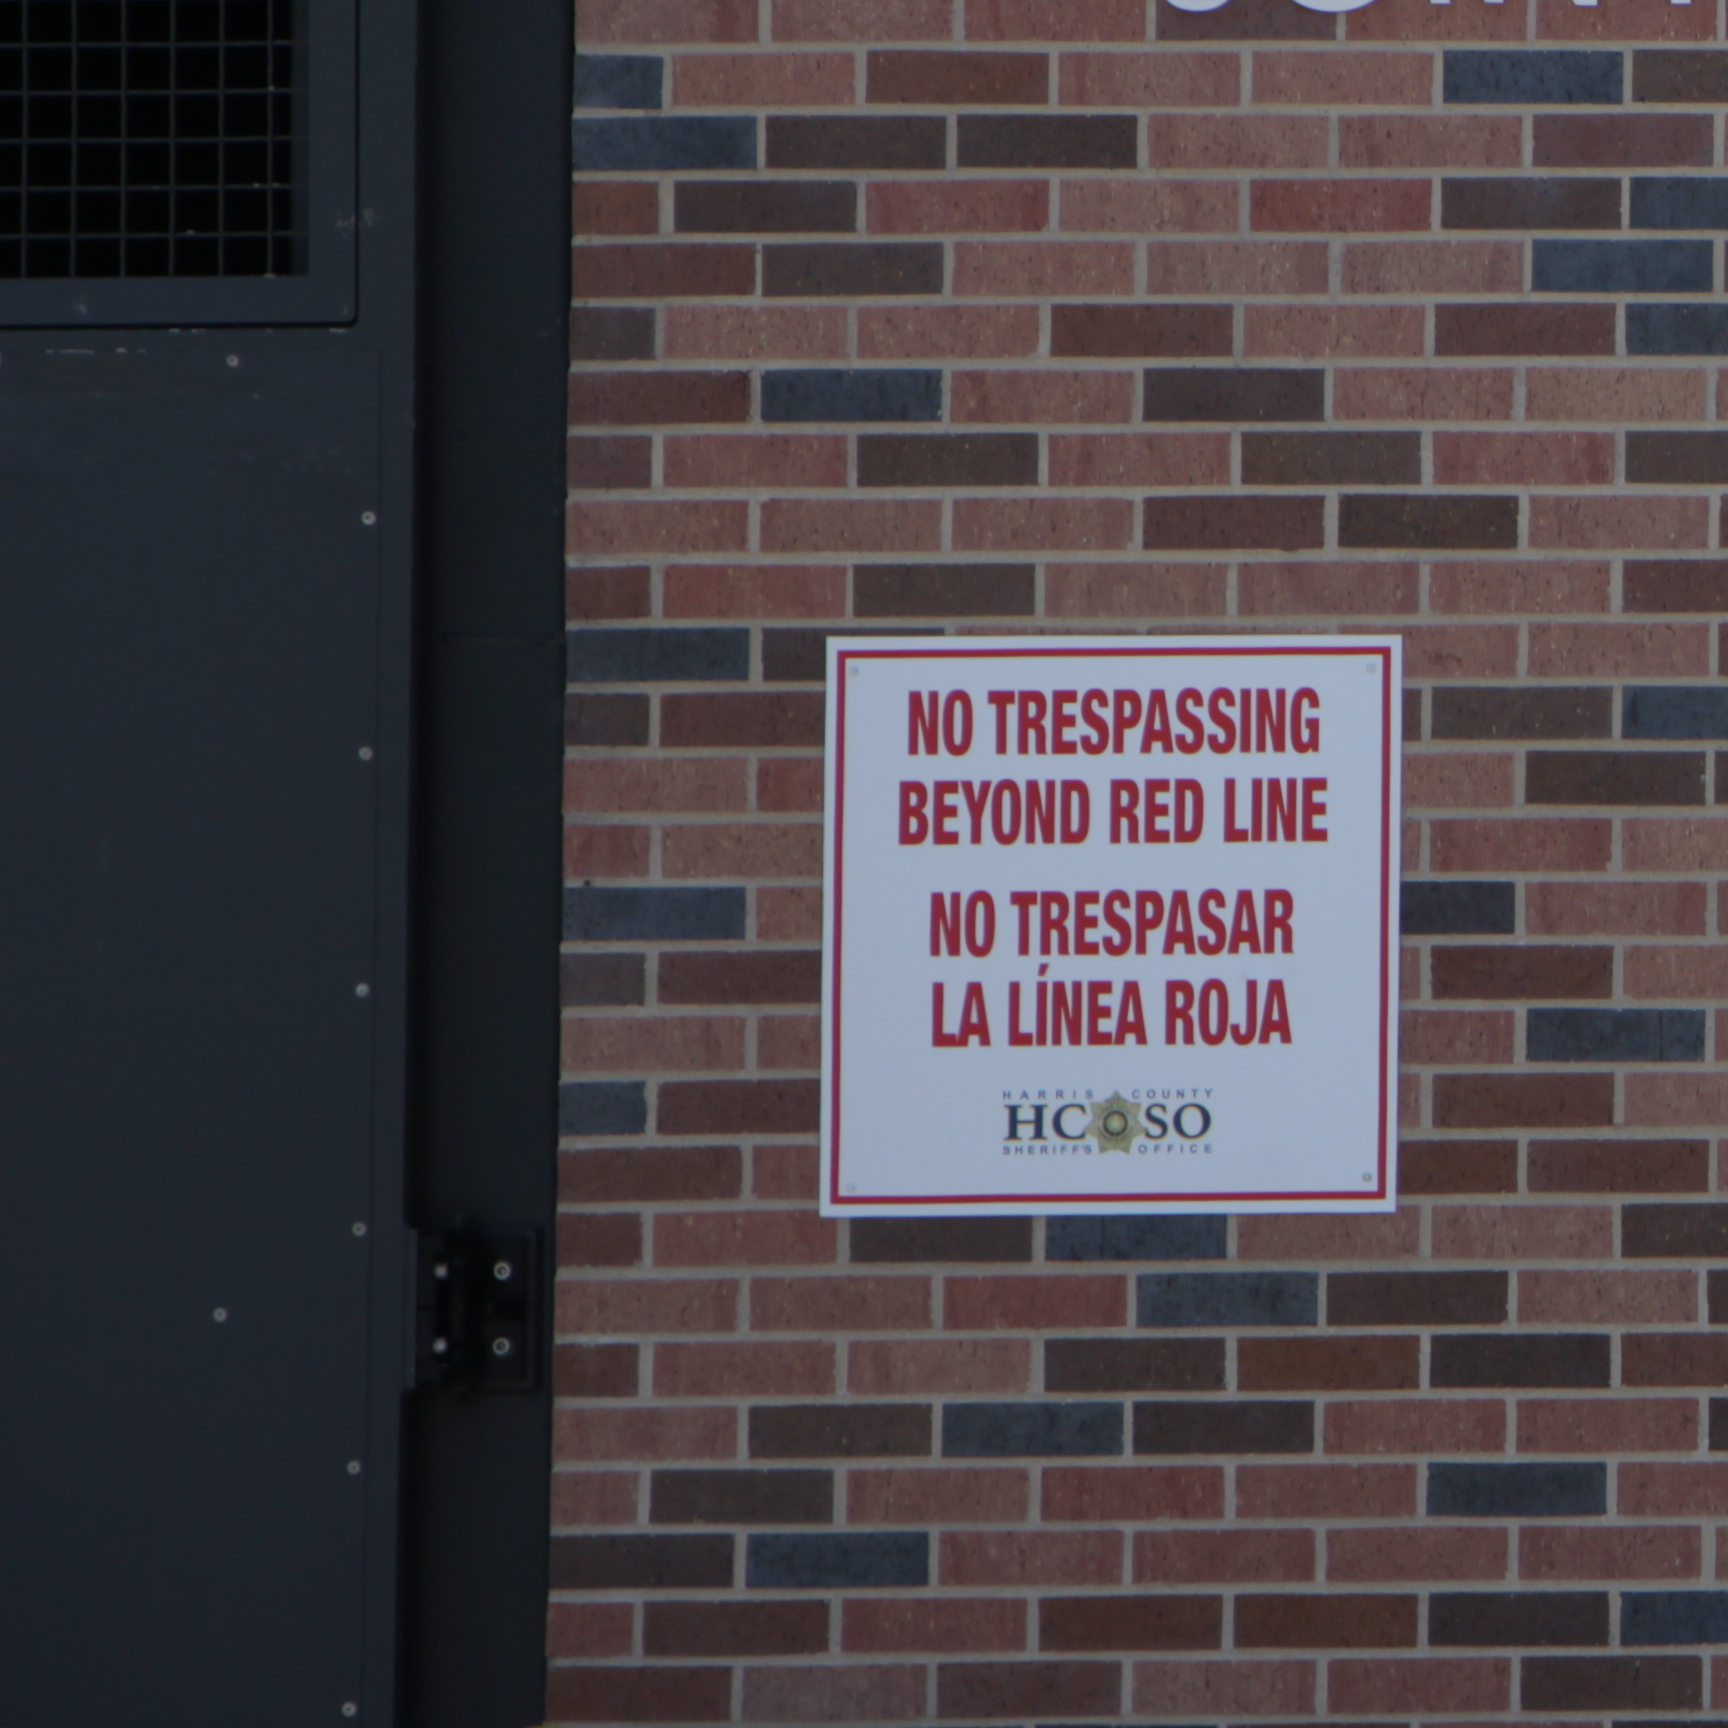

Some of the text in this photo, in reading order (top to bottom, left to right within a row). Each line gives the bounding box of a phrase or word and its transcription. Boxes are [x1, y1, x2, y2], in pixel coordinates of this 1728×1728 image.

[907, 687, 1320, 756] NO TRESPASSING
[899, 777, 1329, 846] BEYOND RED LINE
[929, 888, 1294, 958] NO TRESPASAR
[931, 963, 1292, 1048] LA LÍNEA ROJA
[1002, 1088, 1213, 1101] HARRIS COUNTY
[1002, 1143, 1212, 1156] SHERIFF'S OFFICE
